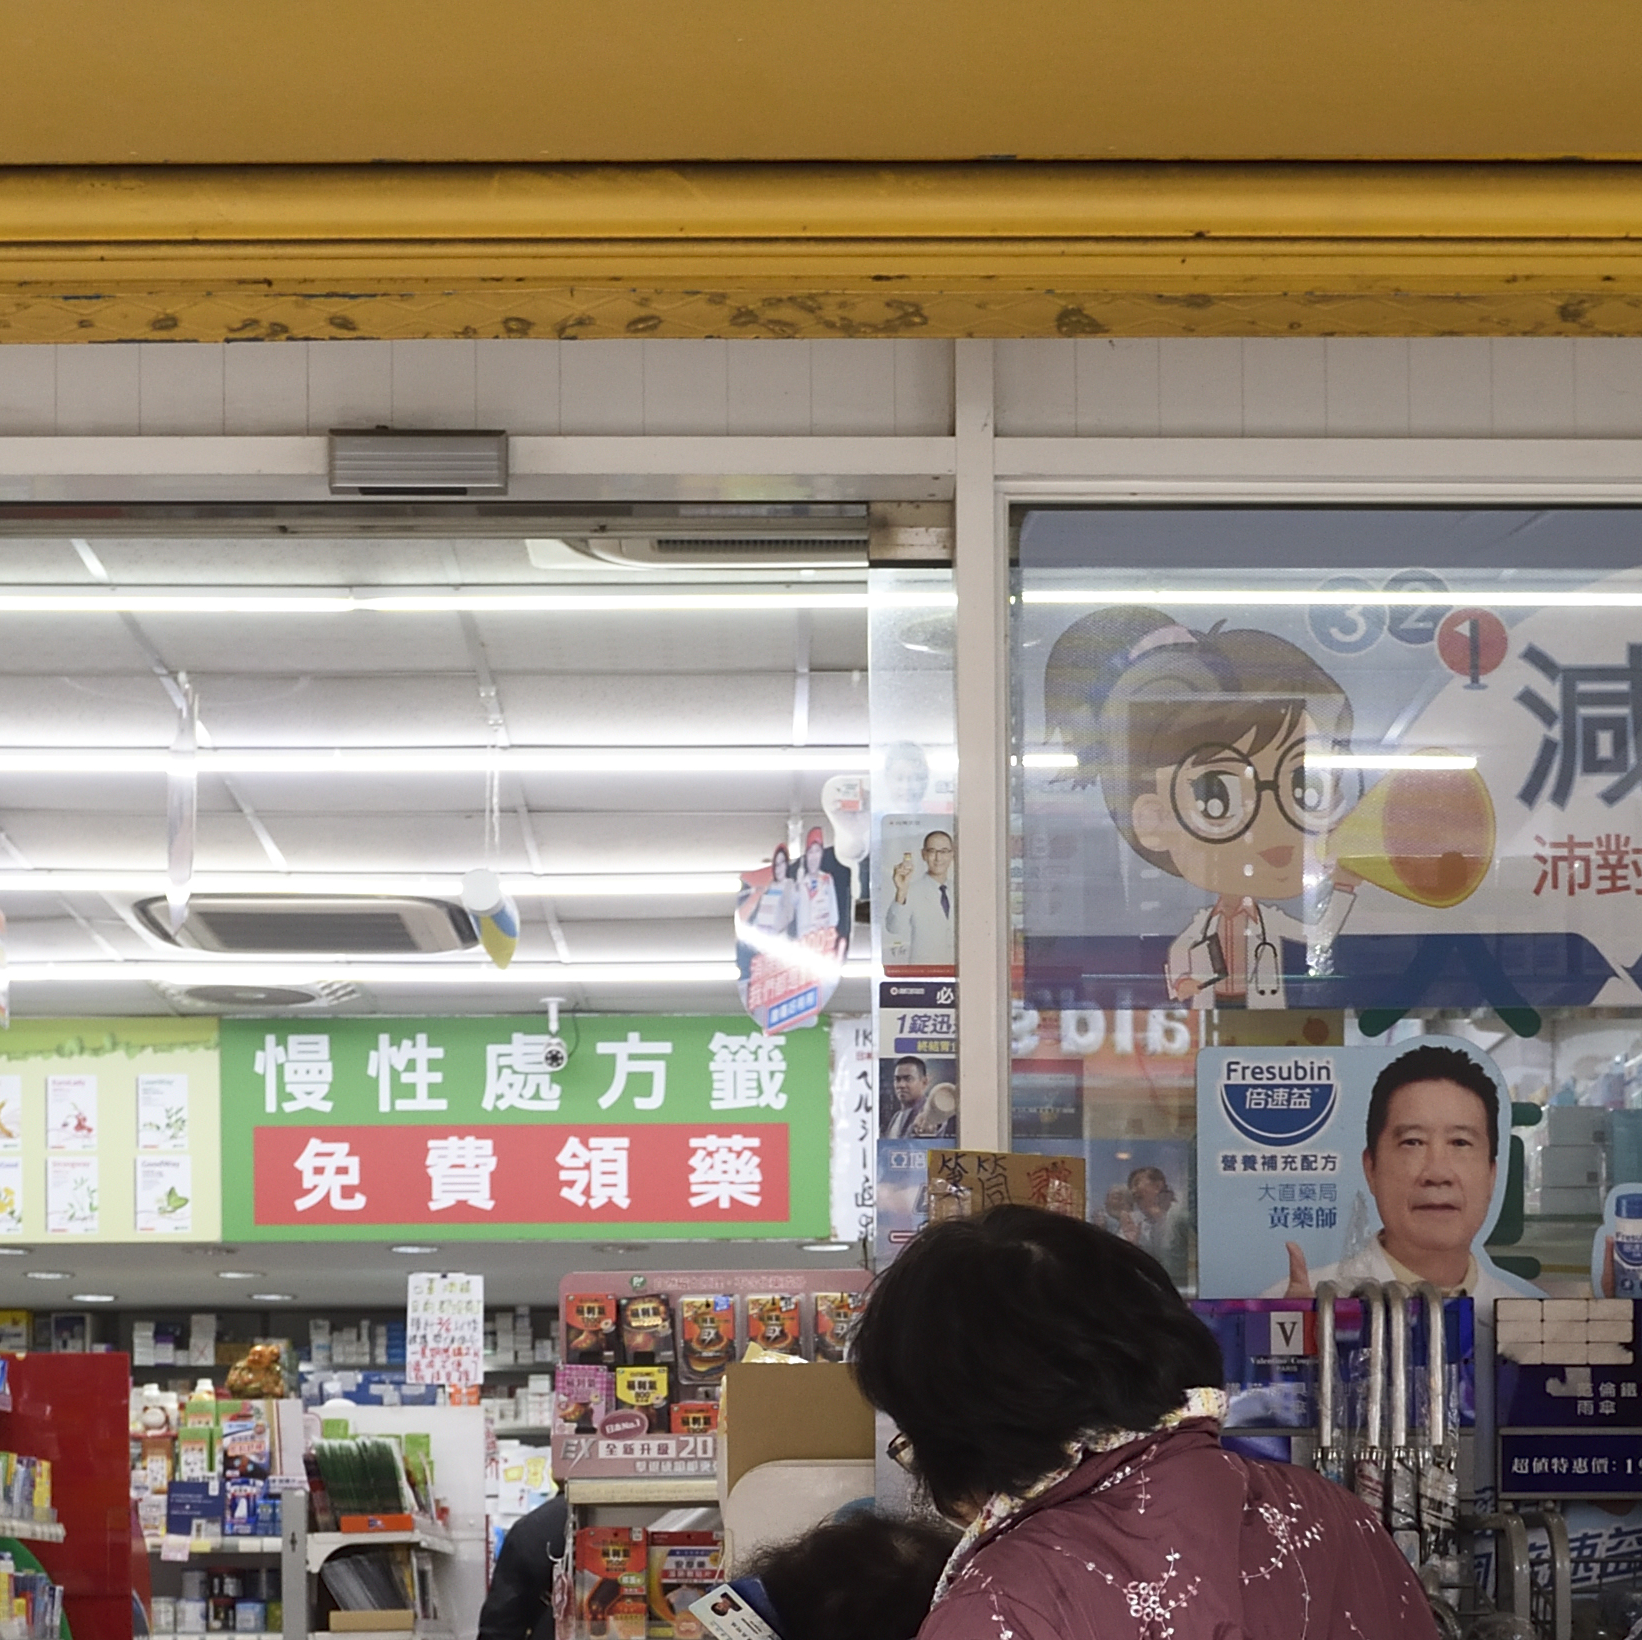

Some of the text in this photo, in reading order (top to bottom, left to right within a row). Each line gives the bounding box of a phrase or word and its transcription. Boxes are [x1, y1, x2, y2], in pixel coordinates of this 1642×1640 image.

[255, 1032, 788, 1114] 慢性處方籤
[1226, 1061, 1331, 1081] Fresubin
[1245, 1088, 1314, 1110] 倍速益
[294, 1135, 761, 1212] 免費領藥
[1220, 1154, 1338, 1172] 營養補充配方
[1257, 1184, 1337, 1201] 大直藥局
[1269, 1207, 1337, 1230] 黃藥師
[1277, 1321, 1298, 1347] V
[1577, 1400, 1616, 1417] 雨傘
[561, 1438, 595, 1469] EX
[606, 1442, 669, 1455] 全新升級
